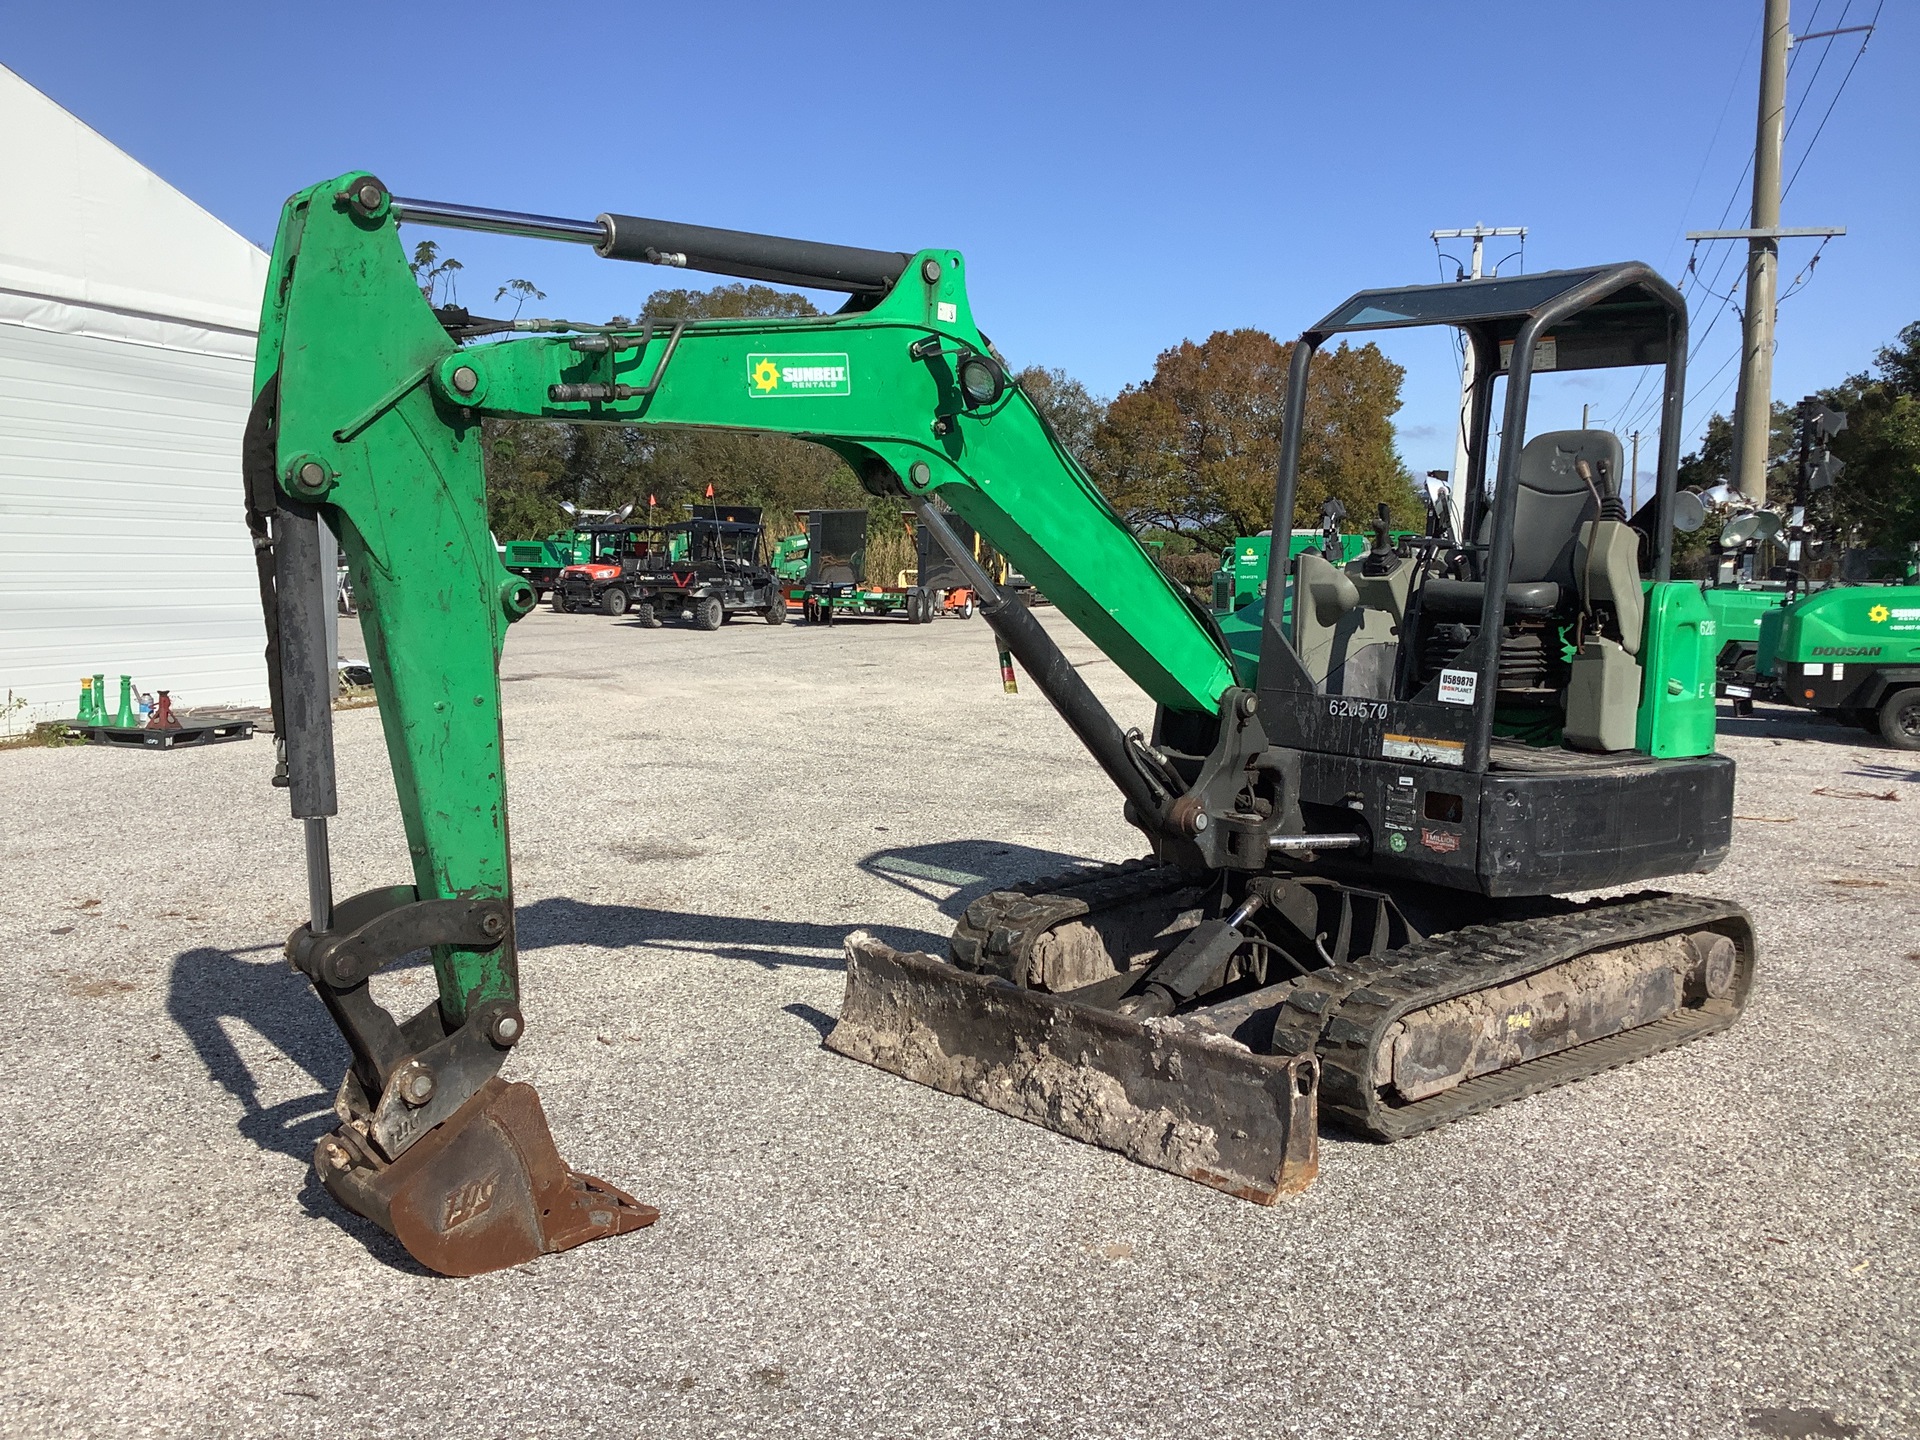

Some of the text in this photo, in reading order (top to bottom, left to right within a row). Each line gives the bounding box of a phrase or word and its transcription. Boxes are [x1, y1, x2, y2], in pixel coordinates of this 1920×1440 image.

[782, 366, 845, 382] SUNBELT
[1812, 646, 1882, 656] DOOSAN
[1442, 674, 1474, 687] U589879
[1430, 834, 1455, 845] MILLION
